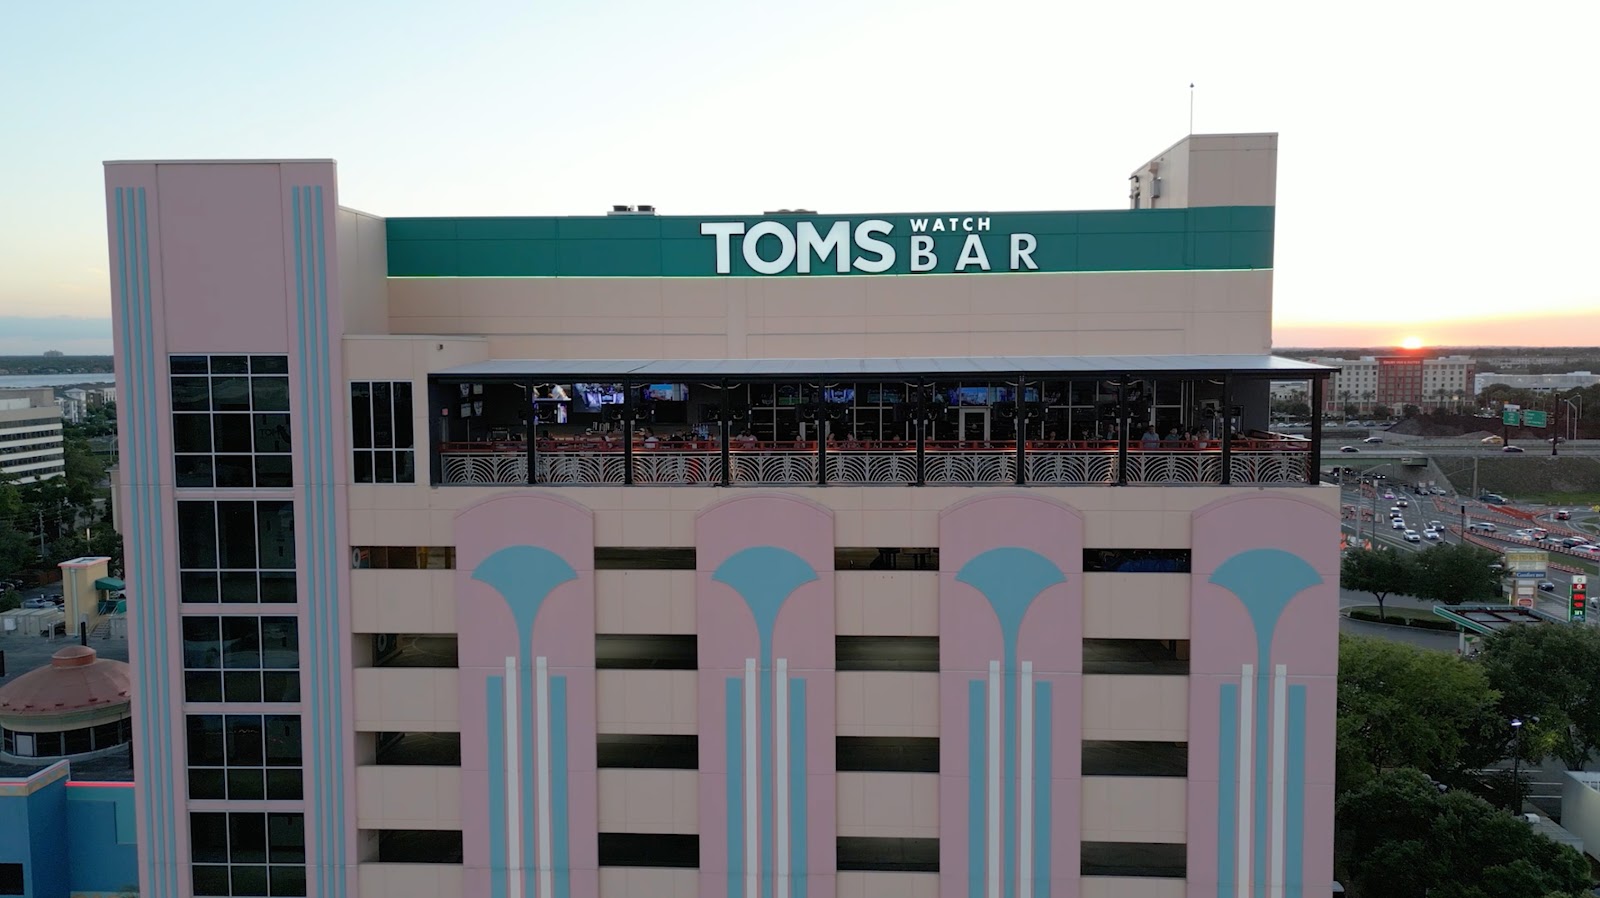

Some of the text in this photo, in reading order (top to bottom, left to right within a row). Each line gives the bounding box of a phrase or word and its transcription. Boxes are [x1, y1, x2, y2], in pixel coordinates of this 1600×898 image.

[909, 217, 991, 232] WATCH
[700, 219, 896, 275] TOMS
[910, 232, 1039, 272] BAR
